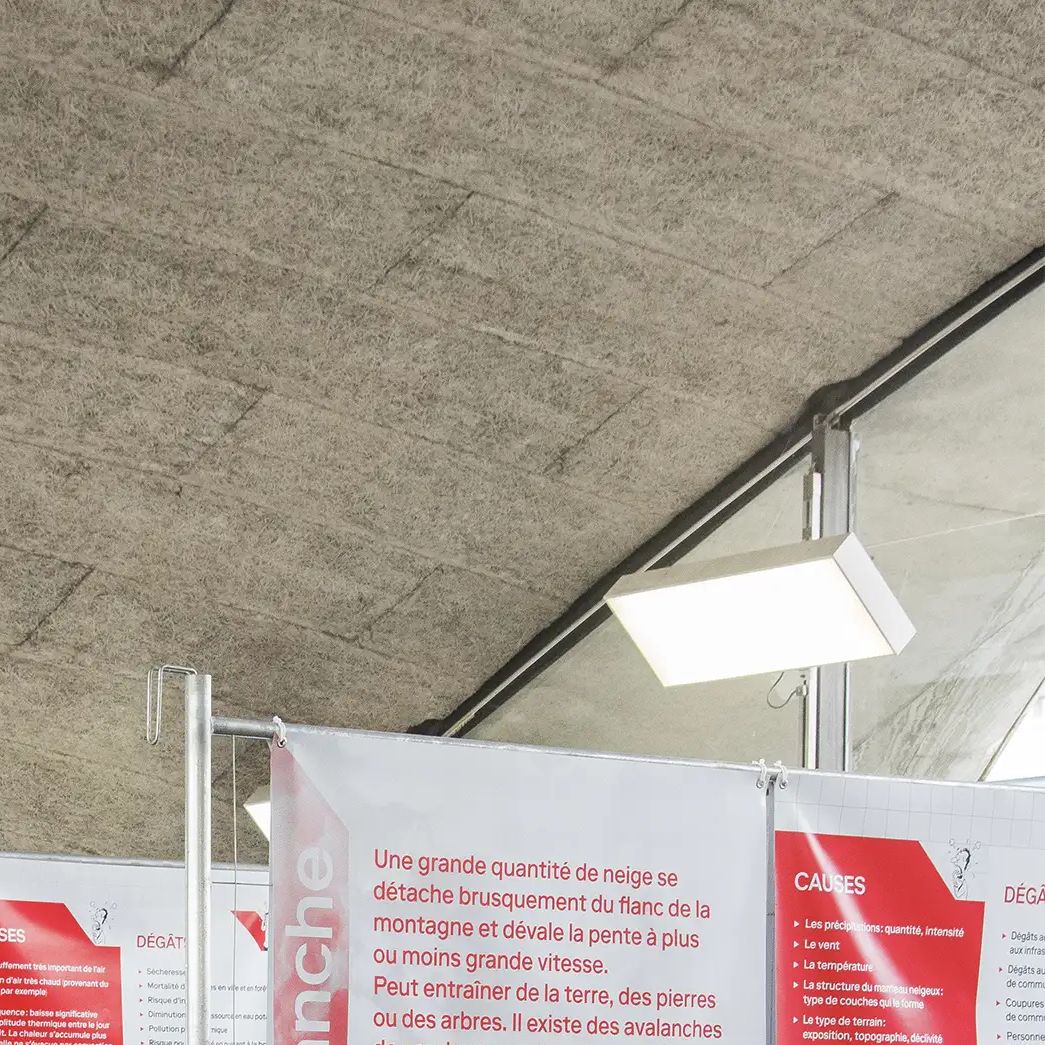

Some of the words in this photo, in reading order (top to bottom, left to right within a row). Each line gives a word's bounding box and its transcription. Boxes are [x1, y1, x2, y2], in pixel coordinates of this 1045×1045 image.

[374, 848, 413, 870] Une
[417, 855, 486, 876] grande
[491, 860, 571, 881] quantité
[575, 862, 598, 882] de
[603, 865, 653, 890] neige
[657, 871, 678, 887] se
[795, 872, 865, 895] CAUSES
[373, 880, 454, 904] détache
[458, 885, 587, 912] brusquement
[590, 894, 613, 914] du
[618, 895, 663, 916] flanc
[668, 898, 691, 918] de
[695, 899, 710, 919] la
[1011, 931, 1037, 942] Dégâts
[805, 940, 816, 949] Le
[819, 941, 839, 950] vent
[373, 948, 397, 965] ou
[402, 946, 461, 968] moins
[465, 951, 533, 973] grande
[537, 952, 607, 974] vitesse.
[804, 960, 815, 969] La
[817, 961, 873, 972] température
[48, 964, 82, 973] important
[1008, 965, 1035, 975] Dégâts
[1006, 998, 1044, 1008] Coupures
[803, 1015, 813, 1024] Le
[815, 1016, 836, 1027] type
[838, 1017, 850, 1026] de
[803, 1030, 852, 1042] exposition,
[855, 1032, 909, 1044] topographie,
[911, 1034, 943, 1044] déclivité
